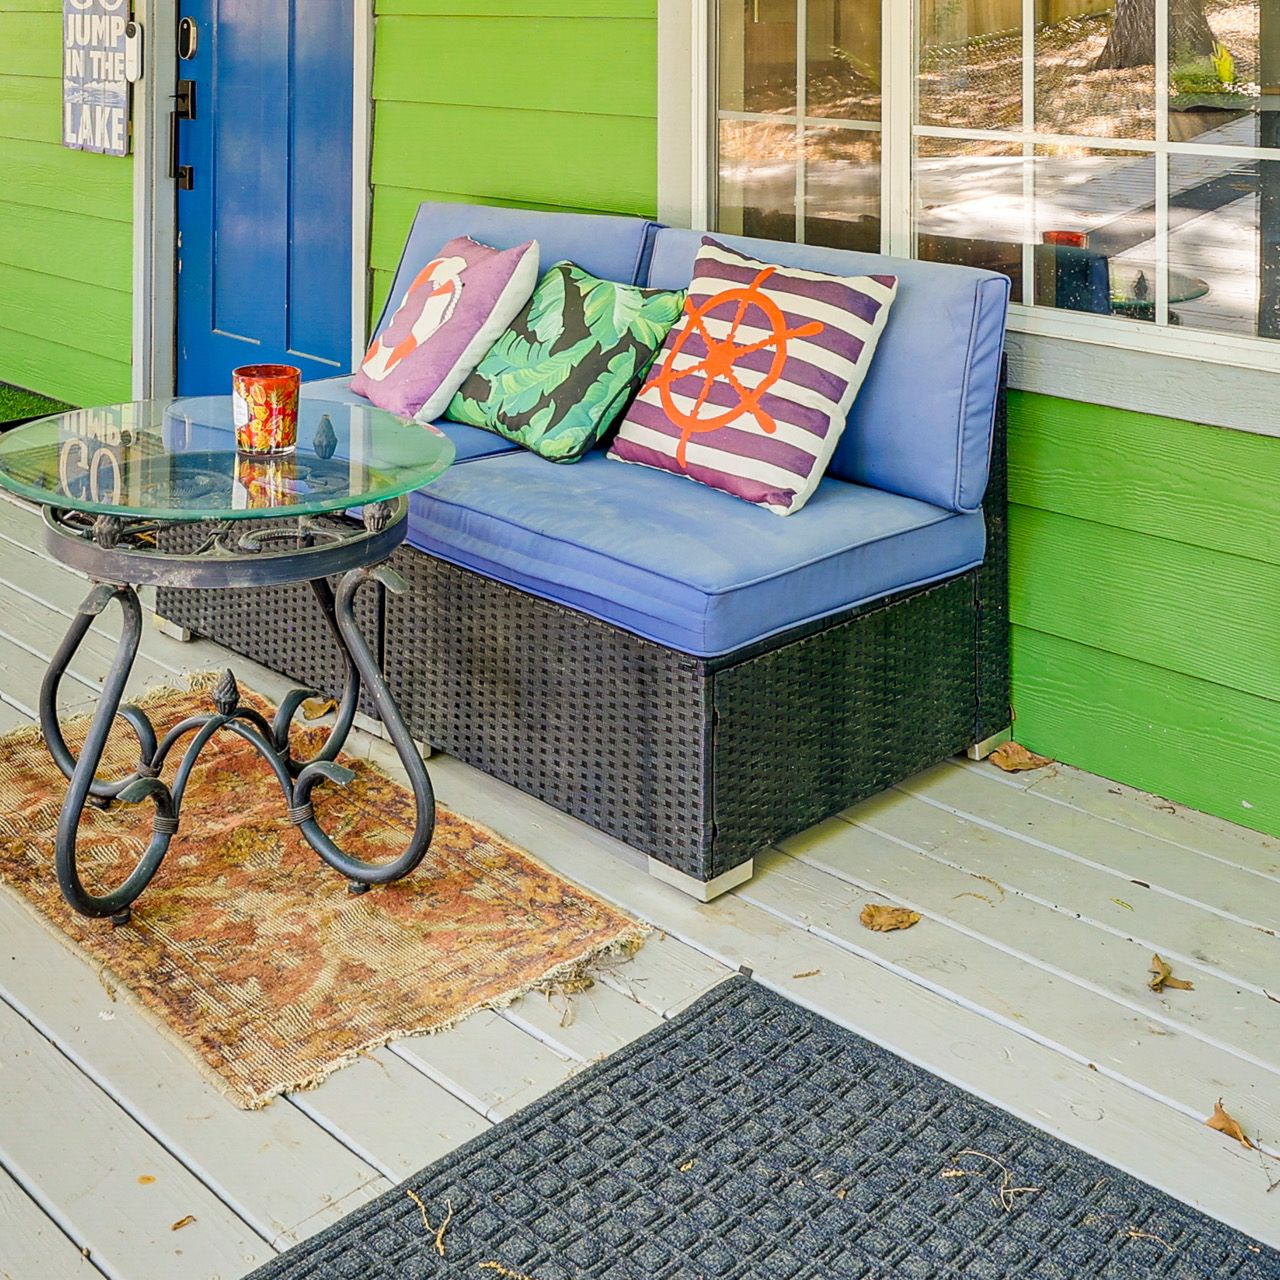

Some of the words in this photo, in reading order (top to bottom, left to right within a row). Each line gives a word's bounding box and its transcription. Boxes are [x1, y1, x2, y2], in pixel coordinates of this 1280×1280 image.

[66, 14, 125, 47] JUMP
[66, 50, 83, 77] IN
[90, 51, 124, 81] THE
[65, 103, 124, 149] LAKE
